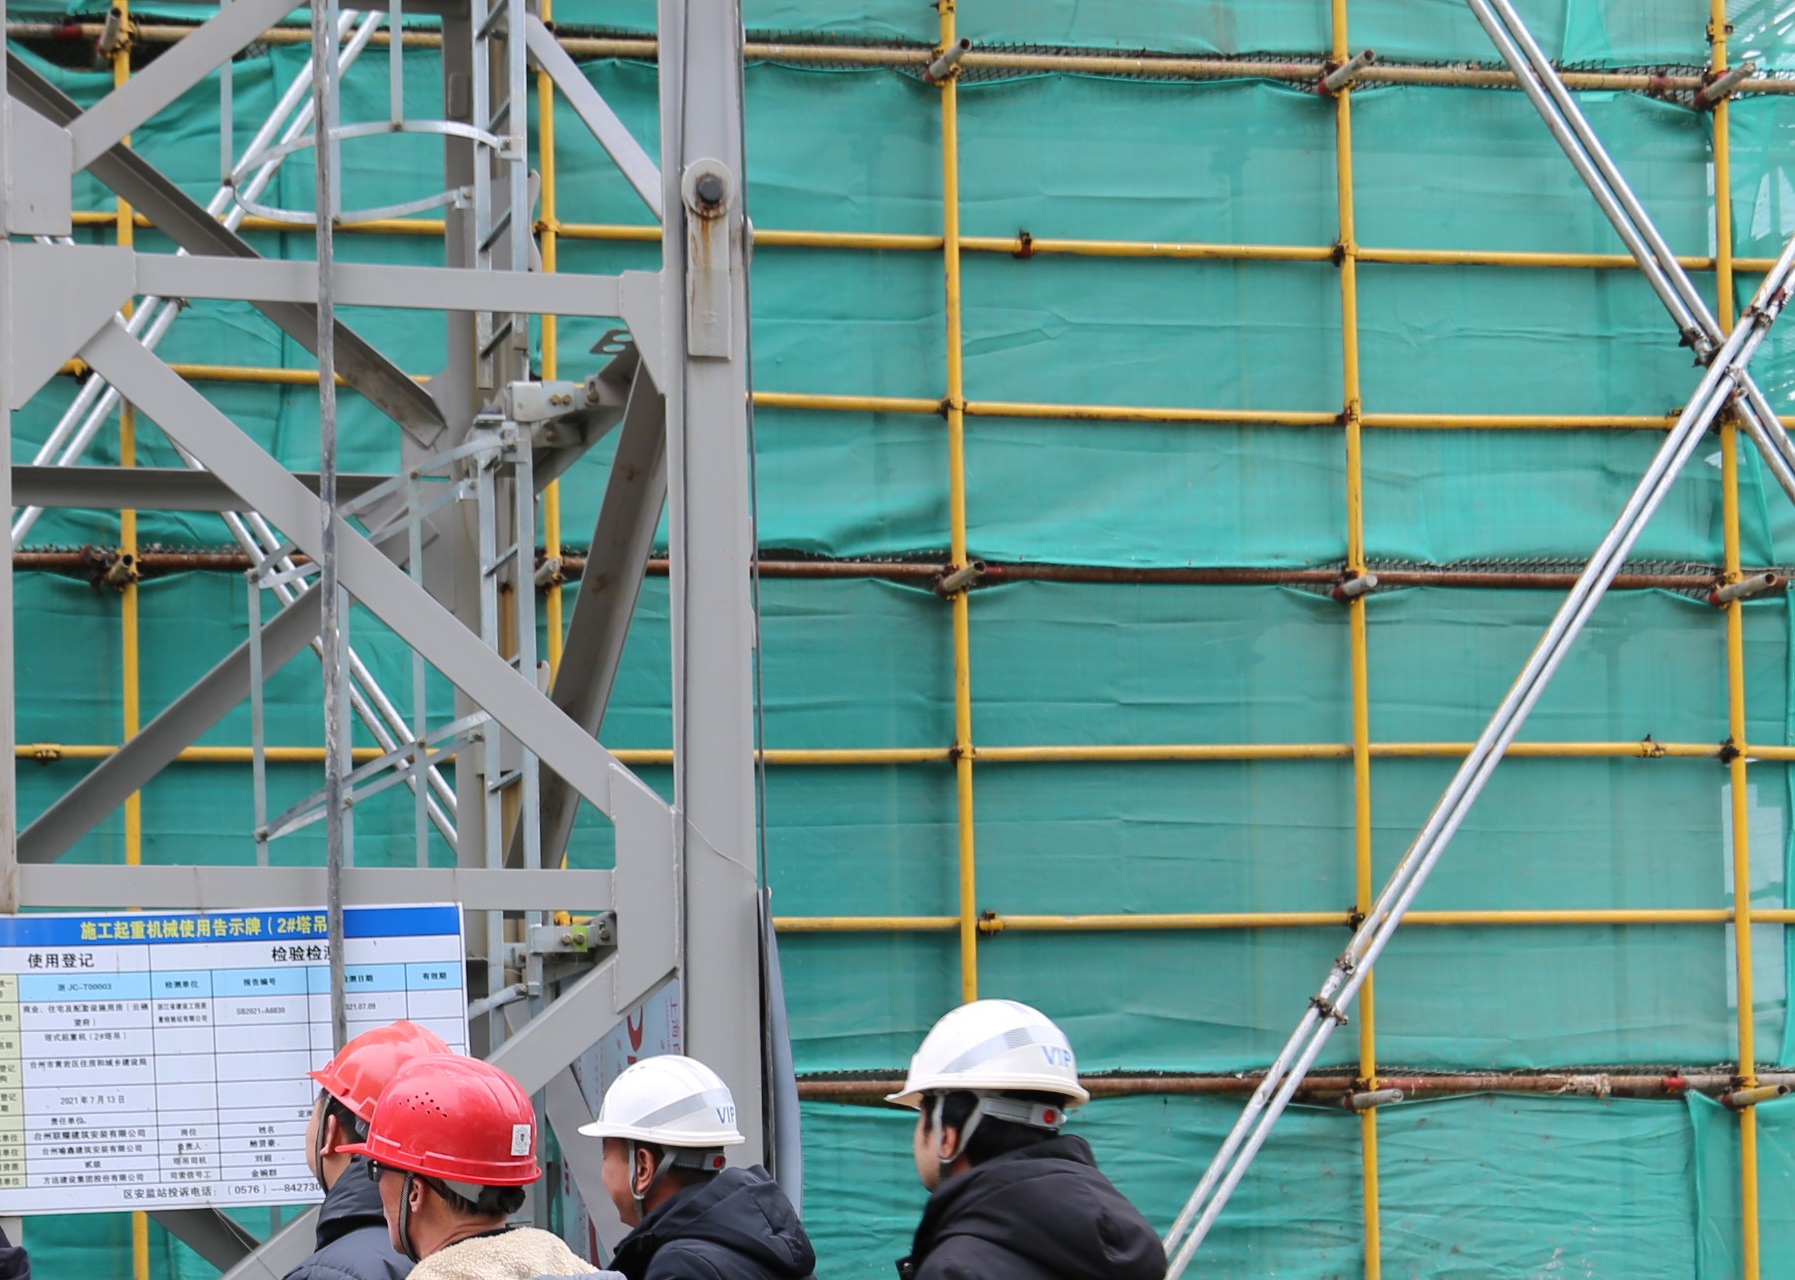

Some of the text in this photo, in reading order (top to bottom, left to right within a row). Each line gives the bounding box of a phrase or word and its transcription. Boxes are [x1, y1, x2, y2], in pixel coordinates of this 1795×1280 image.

[28, 953, 95, 969] 使用登记
[165, 980, 199, 989] 检测单位
[243, 977, 276, 987] 报告编号
[1040, 1045, 1072, 1068] VIP
[716, 1106, 735, 1124] VIP
